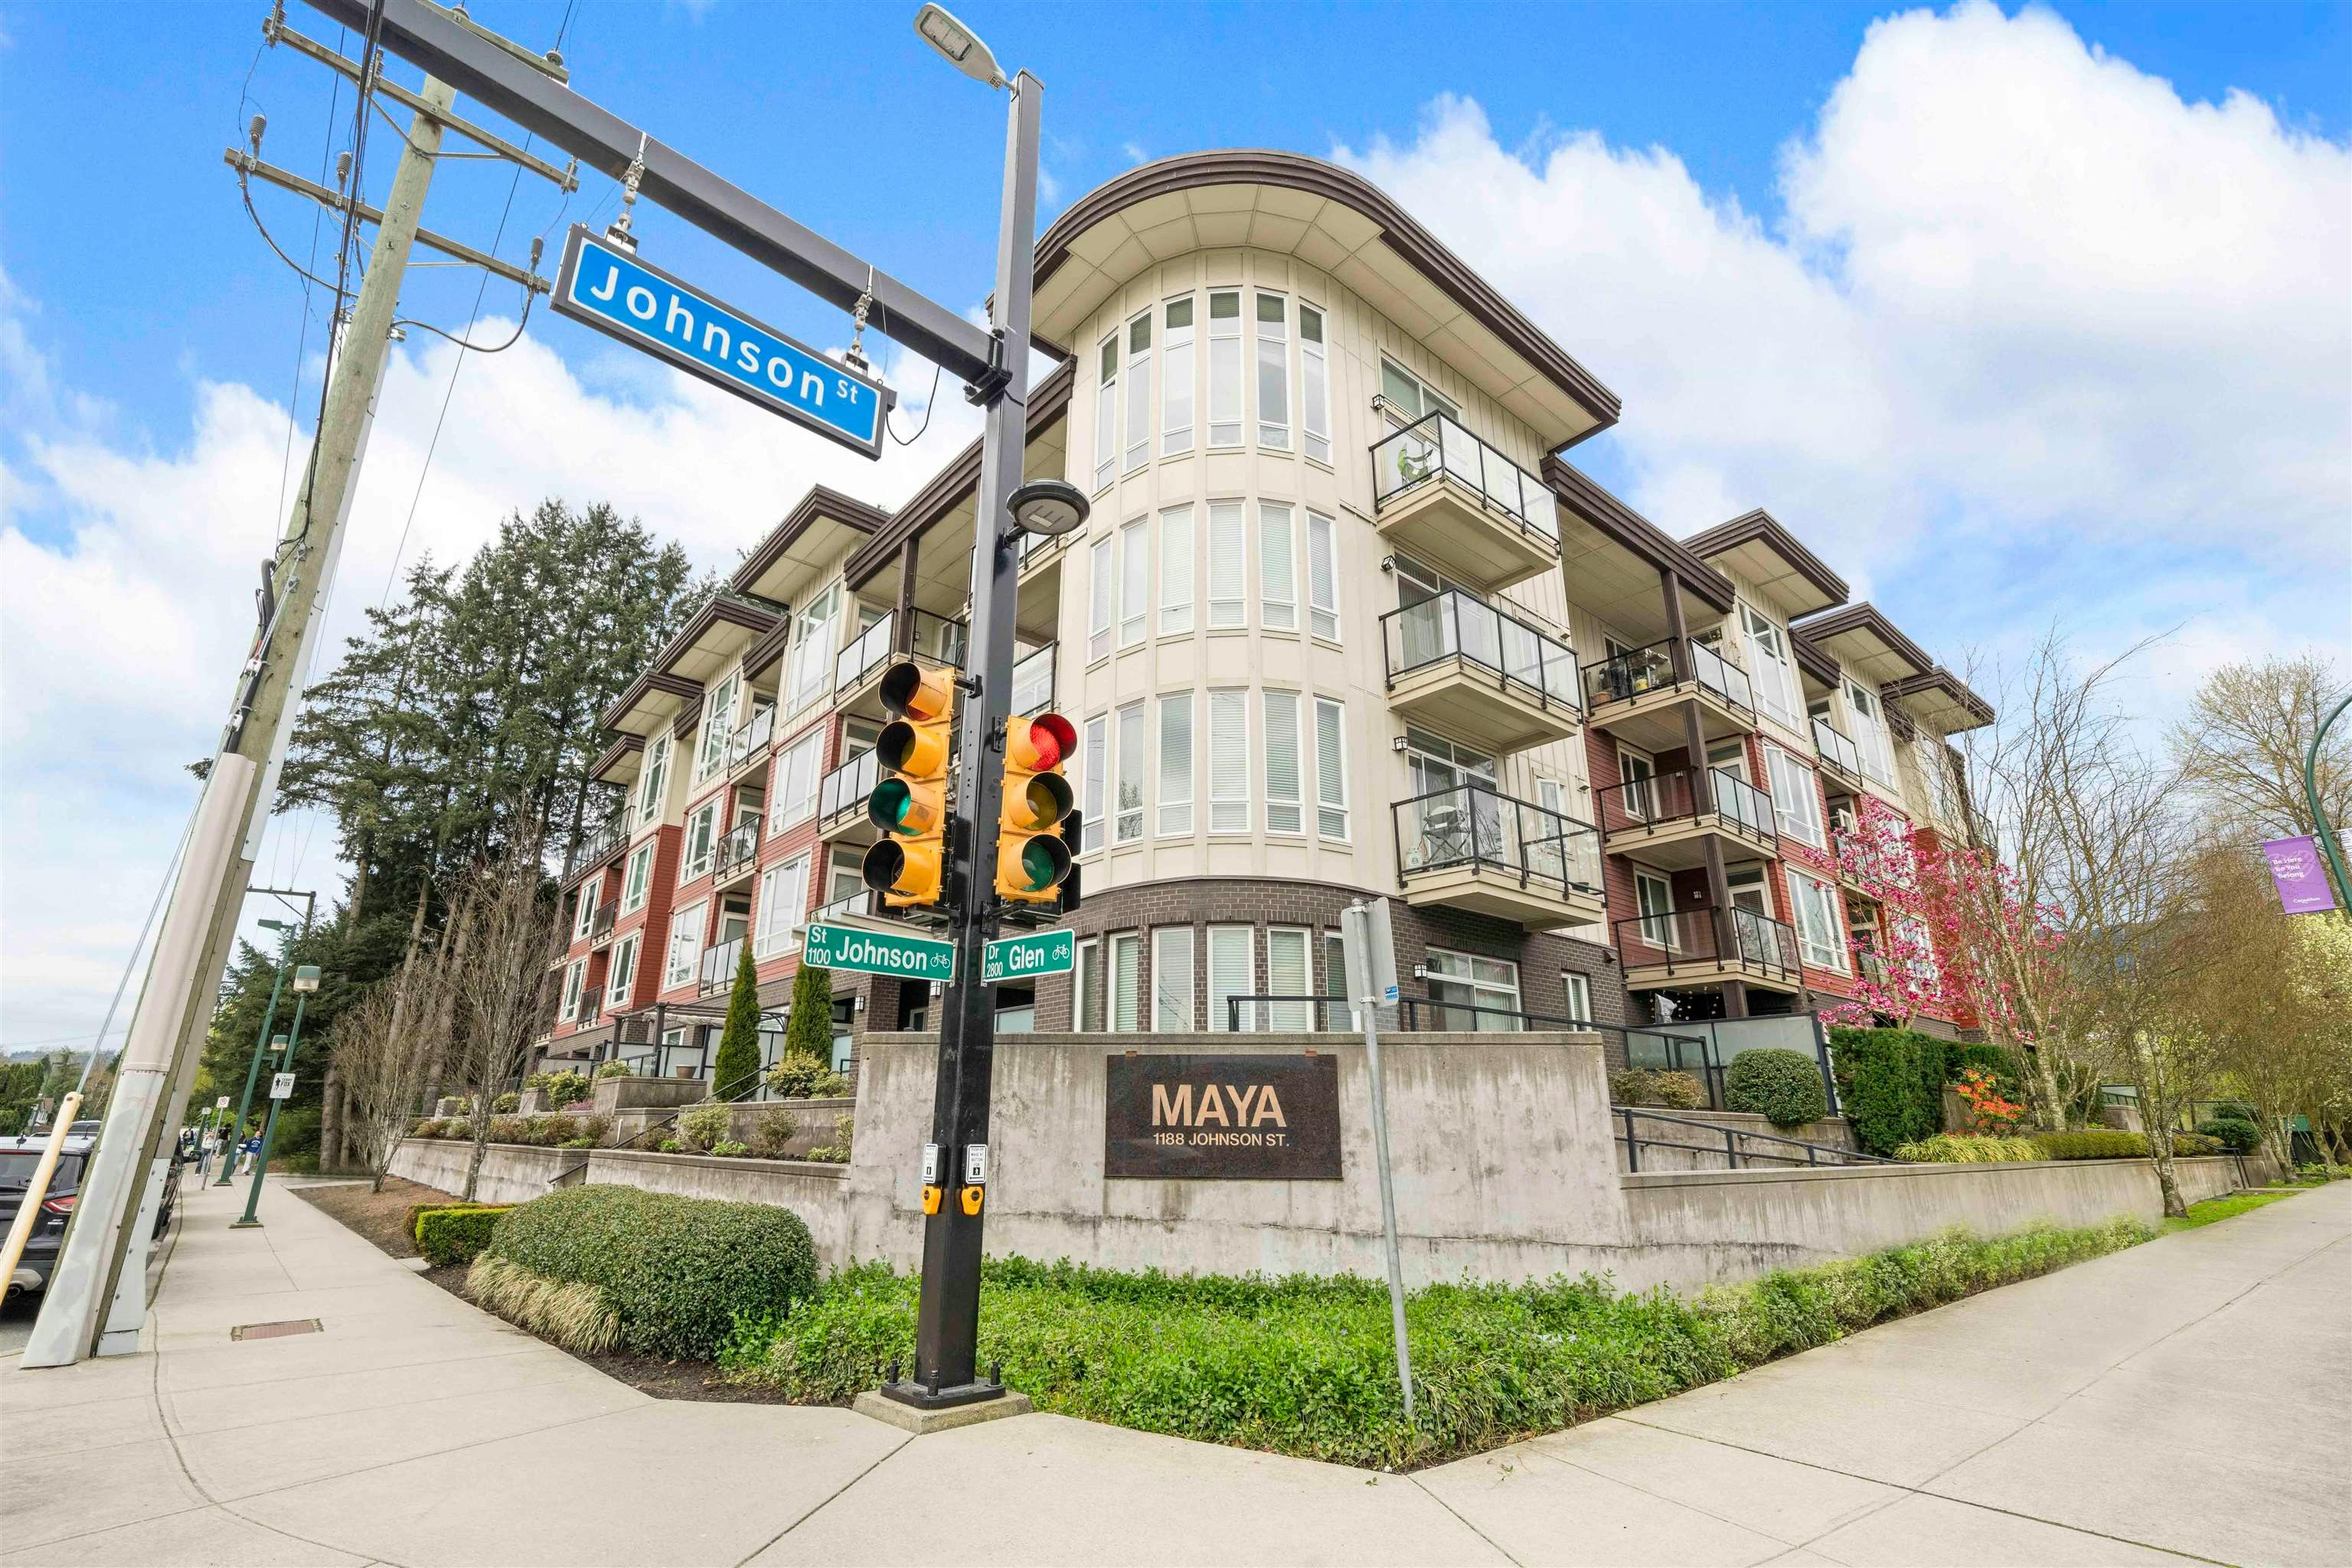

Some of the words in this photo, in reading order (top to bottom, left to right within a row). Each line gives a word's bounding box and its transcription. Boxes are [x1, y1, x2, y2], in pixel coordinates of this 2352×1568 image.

[590, 266, 825, 407] Johnson
[836, 378, 858, 405] St
[810, 926, 827, 944] St
[808, 947, 831, 965] 1100
[835, 936, 928, 972] Johnson
[986, 962, 1004, 978] 2800
[1009, 944, 1044, 971] Glen
[988, 945, 1000, 960] Dr
[1152, 1083, 1287, 1128] MAYA
[1153, 1132, 1184, 1145] 1188
[1188, 1132, 1263, 1146] JOHNSON
[1266, 1133, 1290, 1147] ST.
